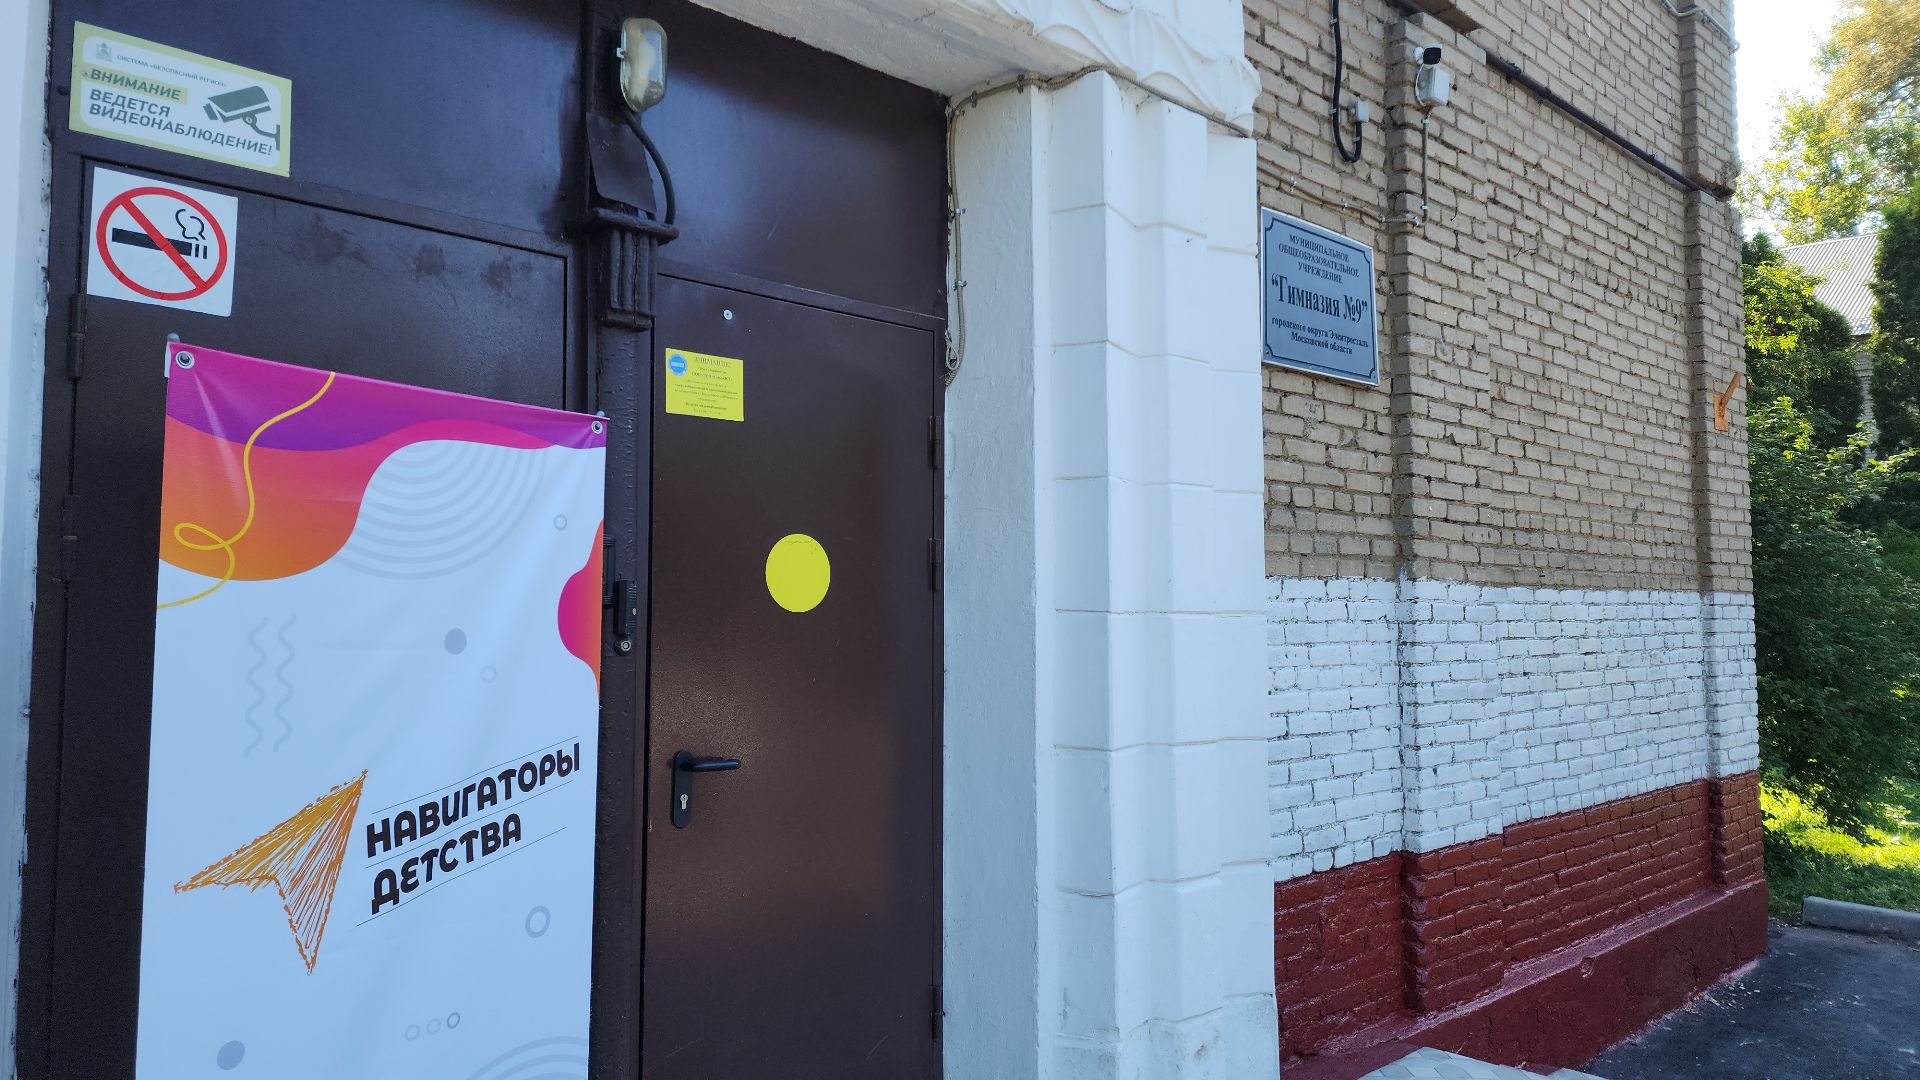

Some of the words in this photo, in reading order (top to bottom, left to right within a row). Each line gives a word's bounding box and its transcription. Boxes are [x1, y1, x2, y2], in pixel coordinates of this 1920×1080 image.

[116, 54, 149, 67] СИСТЕМА
[90, 68, 182, 101] ВНИМАНИЕ
[89, 88, 171, 118] ВЕДЕТСЯ
[88, 104, 273, 156] ВИДЕОНАБЛЮДЕНИЕ!
[1278, 243, 1359, 278] ОБЩЕОБРАЗОВАТЕЛЬНОЕ
[1289, 234, 1349, 263] МУНИЦИПАЛЬНОЕ
[1298, 261, 1343, 284] УЧРЕЖДЕНИЕ
[1271, 316, 1306, 332] городского
[1307, 325, 1329, 338] округа
[1329, 329, 1369, 348] Электросталь
[1291, 332, 1329, 349] Московской
[1329, 342, 1353, 355] области
[366, 742, 580, 859] НАВИГАТОРЫ
[371, 813, 522, 915] ДЕТСТВА
